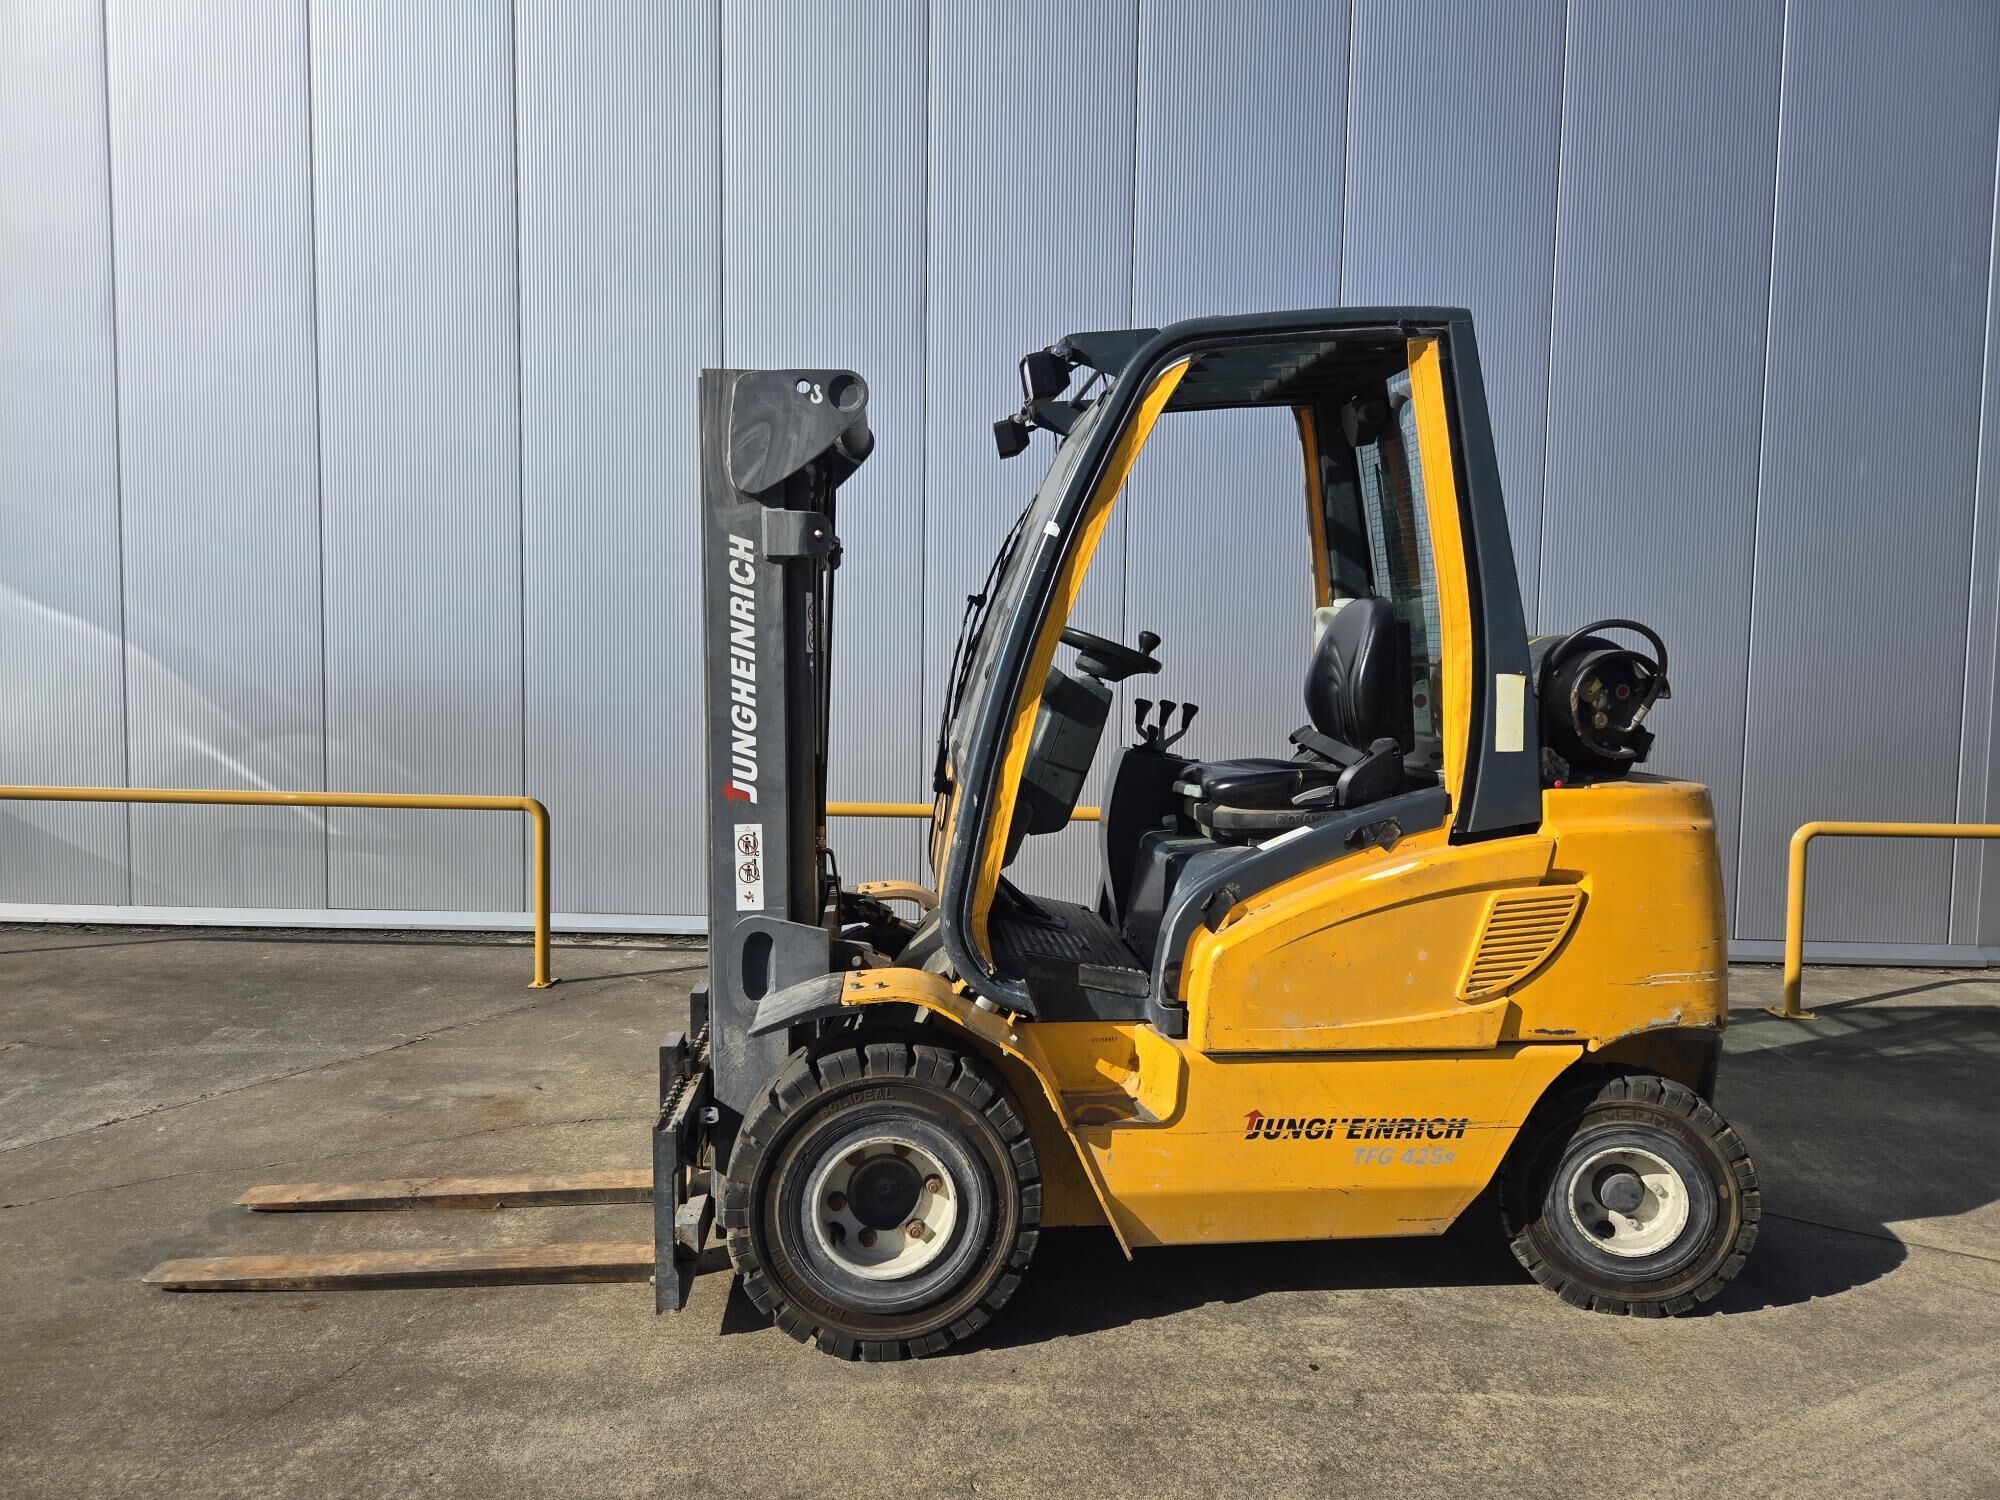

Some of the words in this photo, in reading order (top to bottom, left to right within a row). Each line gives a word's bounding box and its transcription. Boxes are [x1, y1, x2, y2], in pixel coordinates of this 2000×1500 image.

[729, 533, 758, 805] JUNGHEINRICH
[820, 1088, 896, 1119] SOLIDEAL
[1352, 1147, 1394, 1166] TFG
